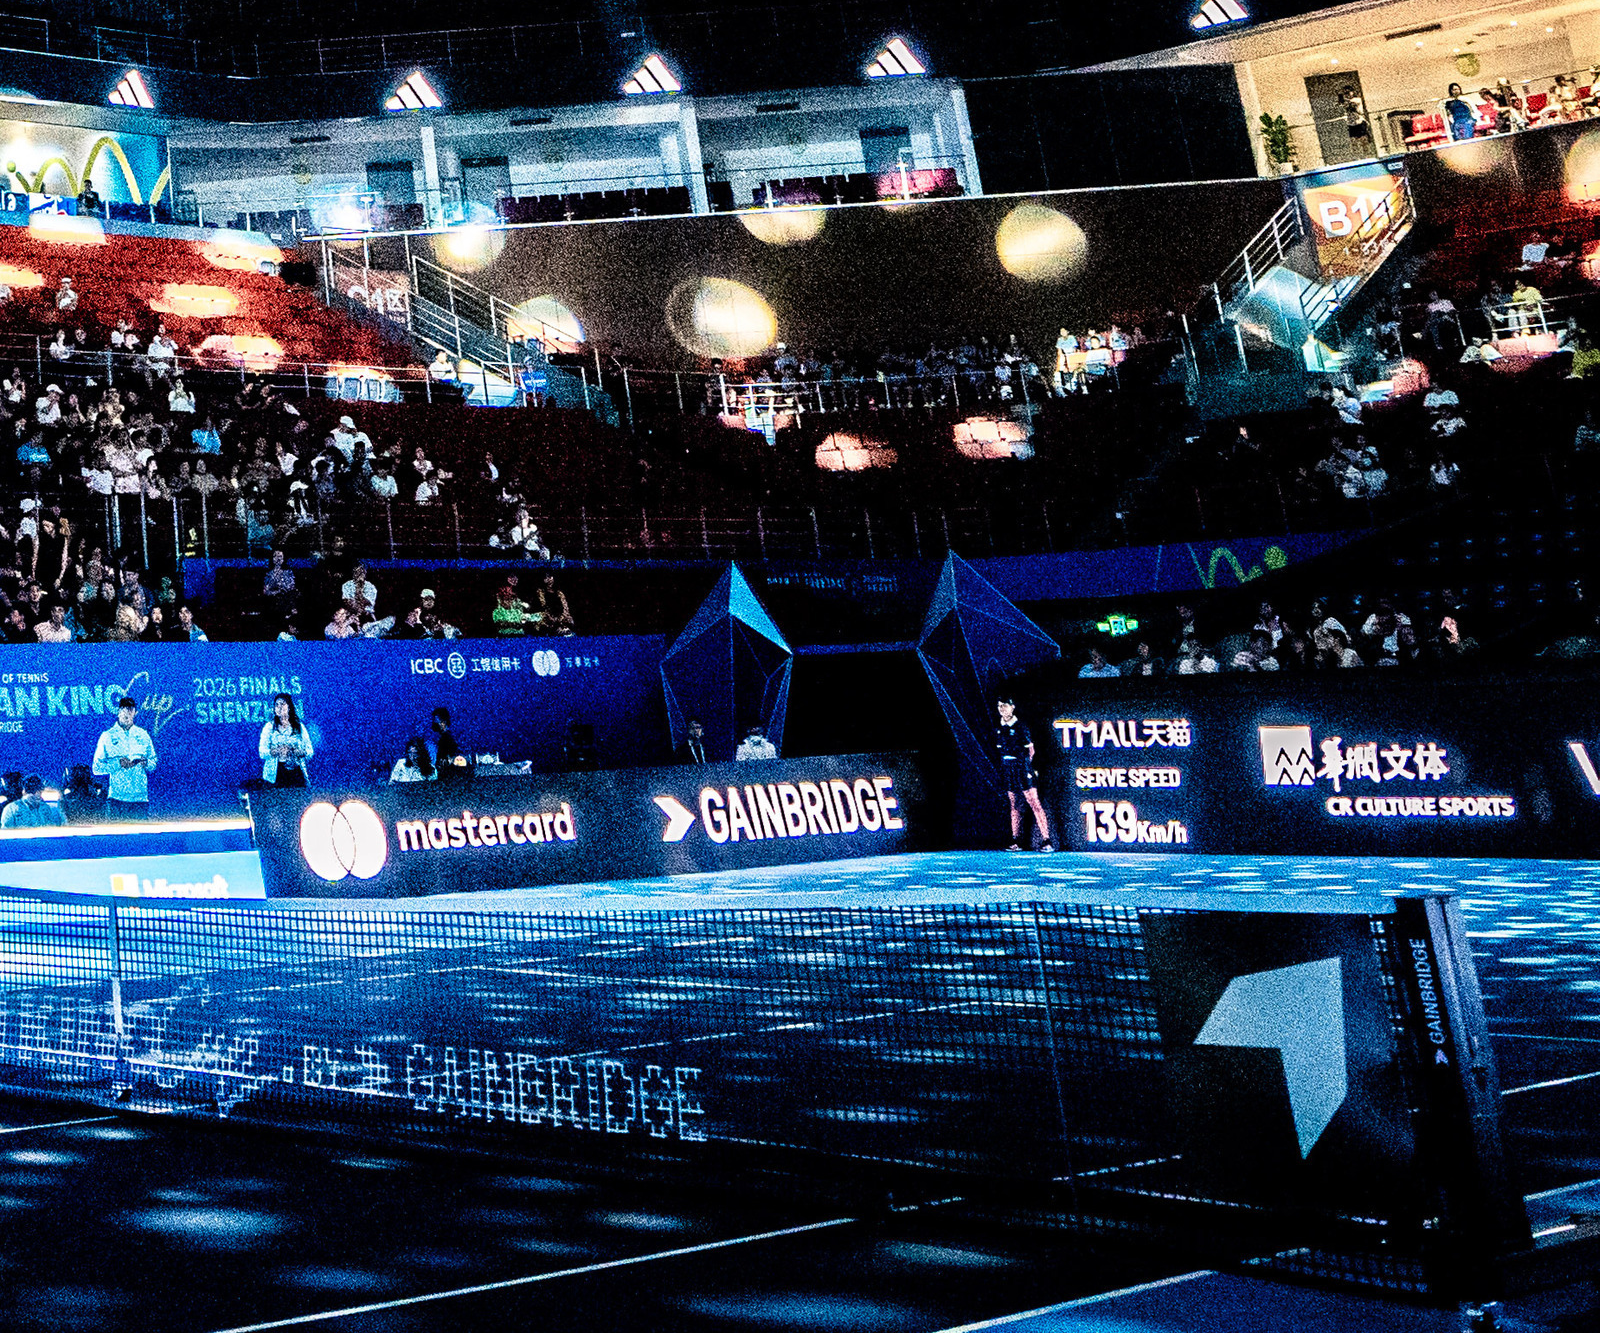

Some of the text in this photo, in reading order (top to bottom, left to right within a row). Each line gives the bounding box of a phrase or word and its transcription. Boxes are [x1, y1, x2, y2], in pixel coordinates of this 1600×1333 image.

[410, 658, 444, 674] ICBC
[2, 673, 14, 683] OF
[17, 672, 50, 683] TENNIS
[193, 675, 302, 697] 2026 FINALS
[1075, 767, 1181, 788] SERVE SPEED
[700, 776, 904, 844] GAINBRIDGE
[1326, 797, 1516, 817] CR CULTURE SPORTS
[397, 802, 576, 852] mastercard
[1409, 938, 1447, 1045] GAINBRIDGE
[407, 1043, 707, 1141] GAINBRIDGE
